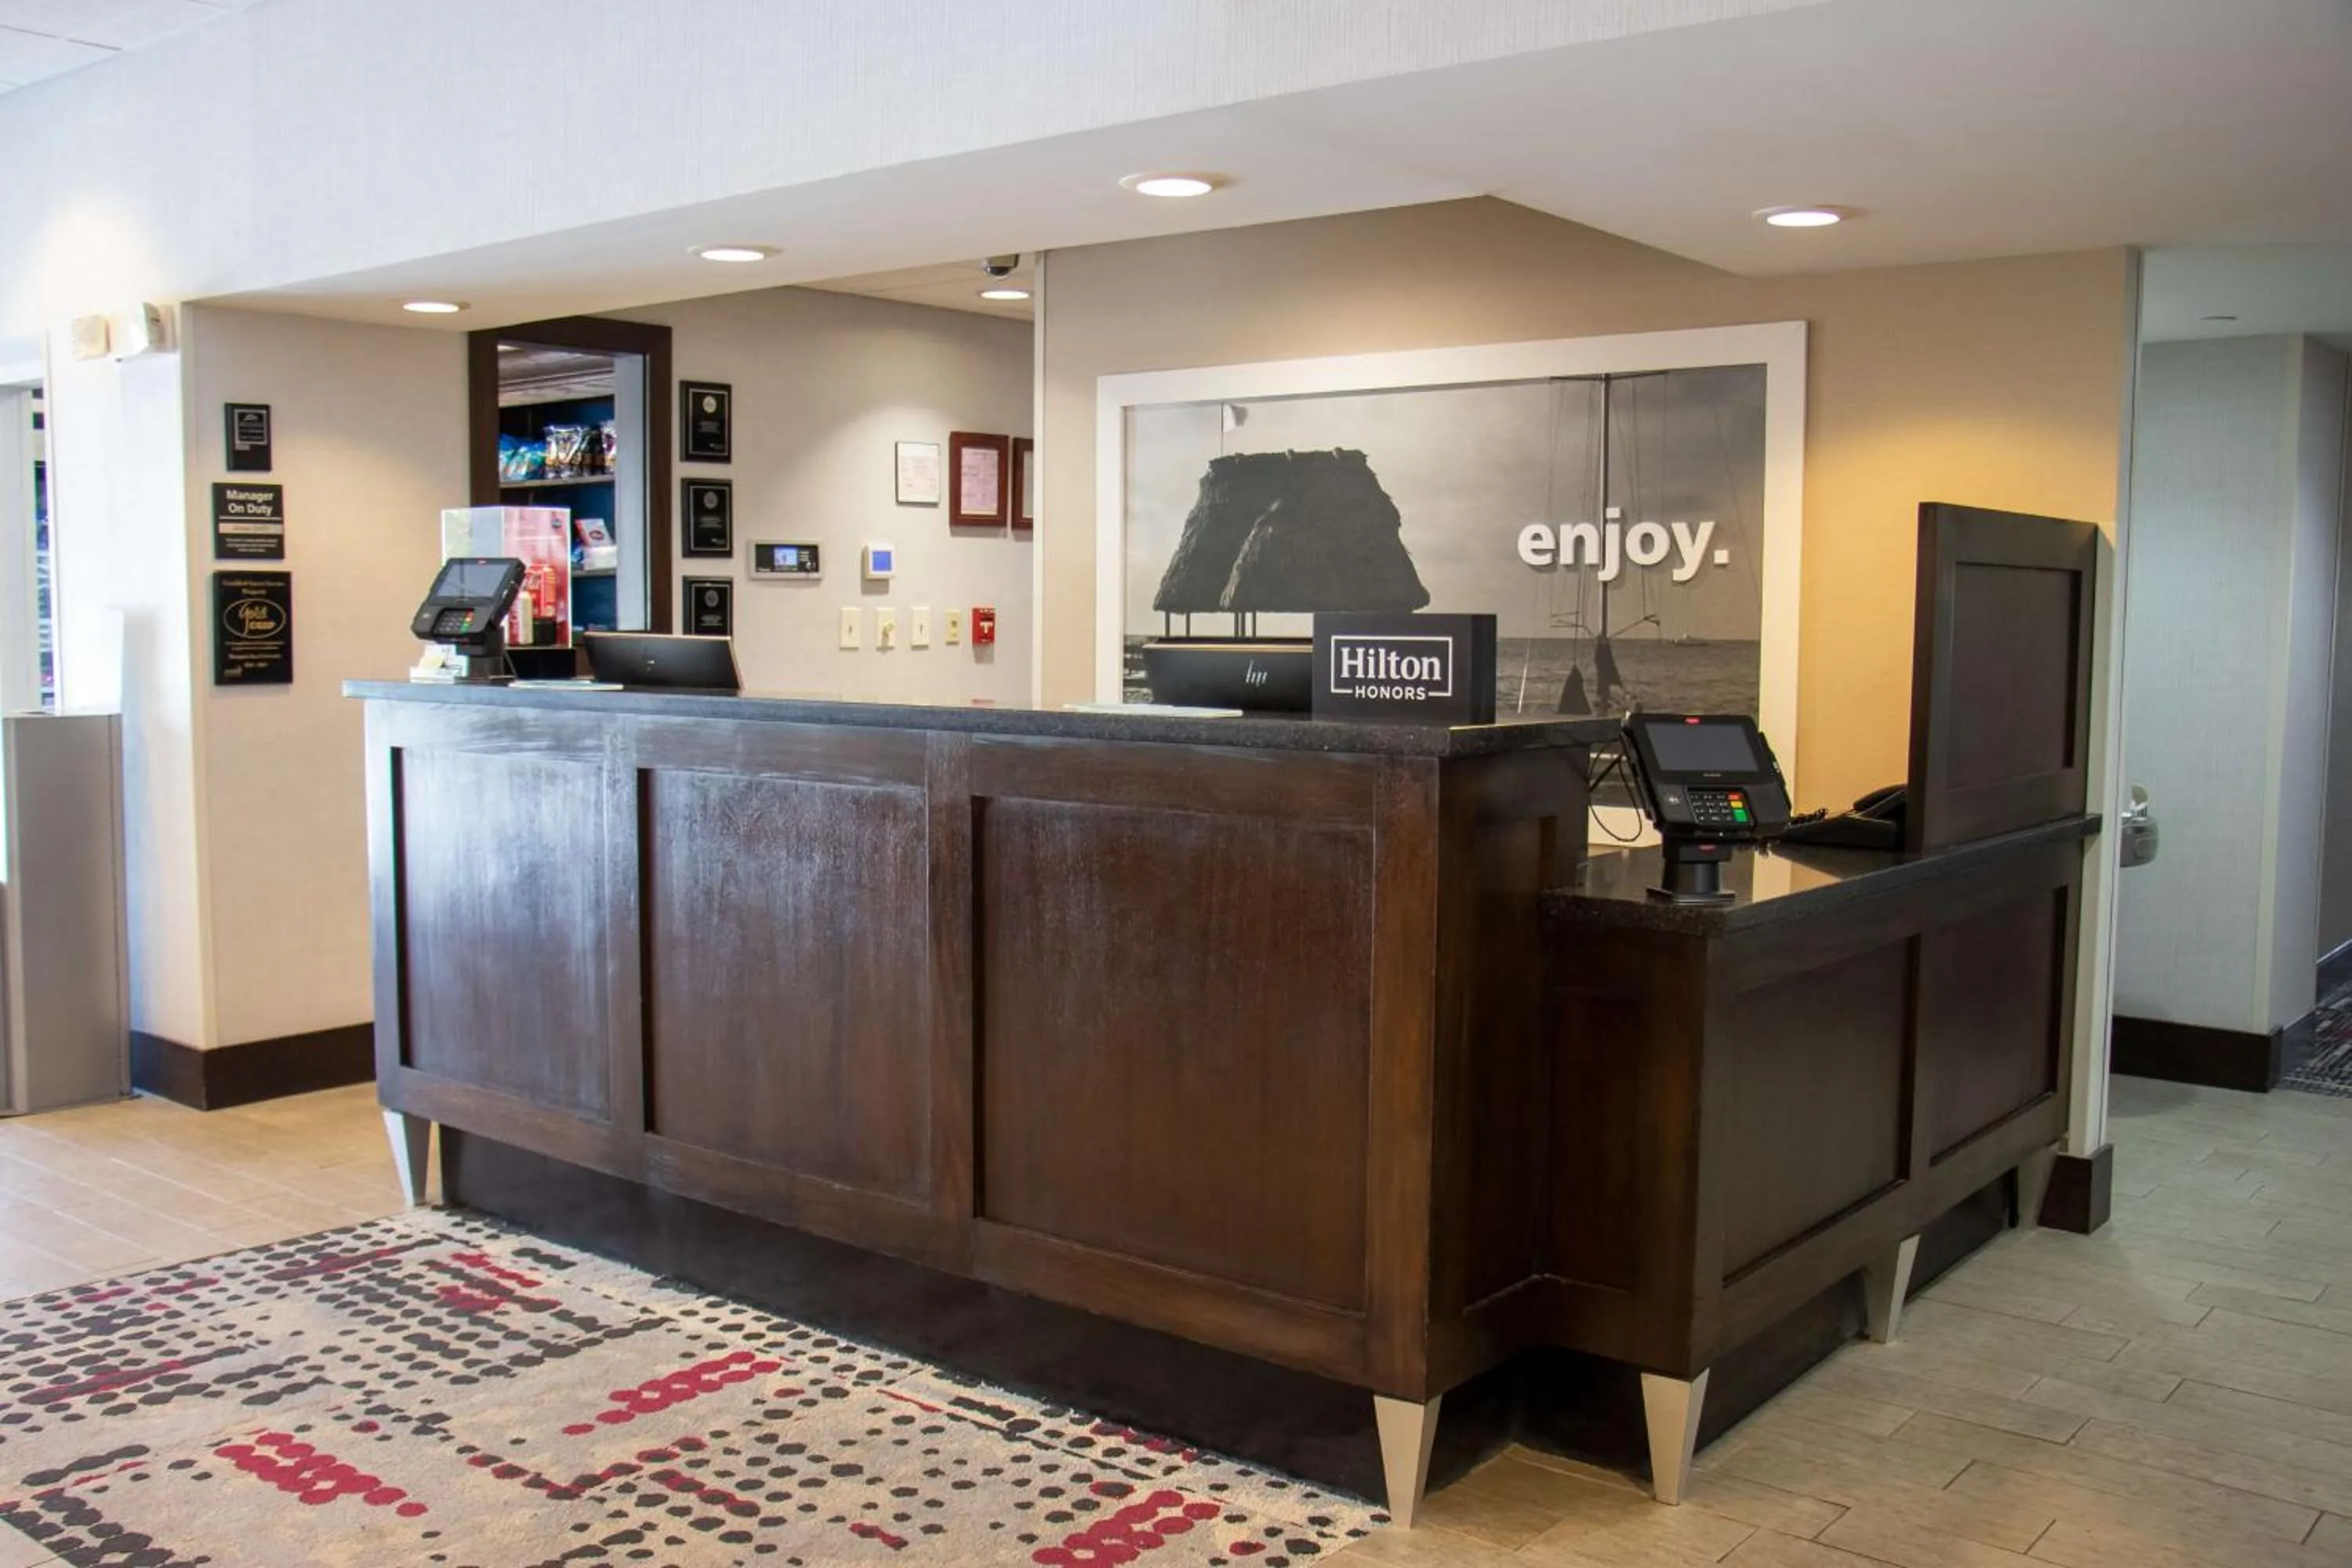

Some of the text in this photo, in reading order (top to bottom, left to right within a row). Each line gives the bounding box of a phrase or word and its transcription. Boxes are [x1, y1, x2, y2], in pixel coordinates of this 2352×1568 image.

[226, 489, 274, 503] Manager
[228, 503, 273, 517] On Duty
[1517, 506, 1730, 582] enjoy.
[1340, 646, 1442, 681] Hilton
[1355, 684, 1427, 700] HONORS
